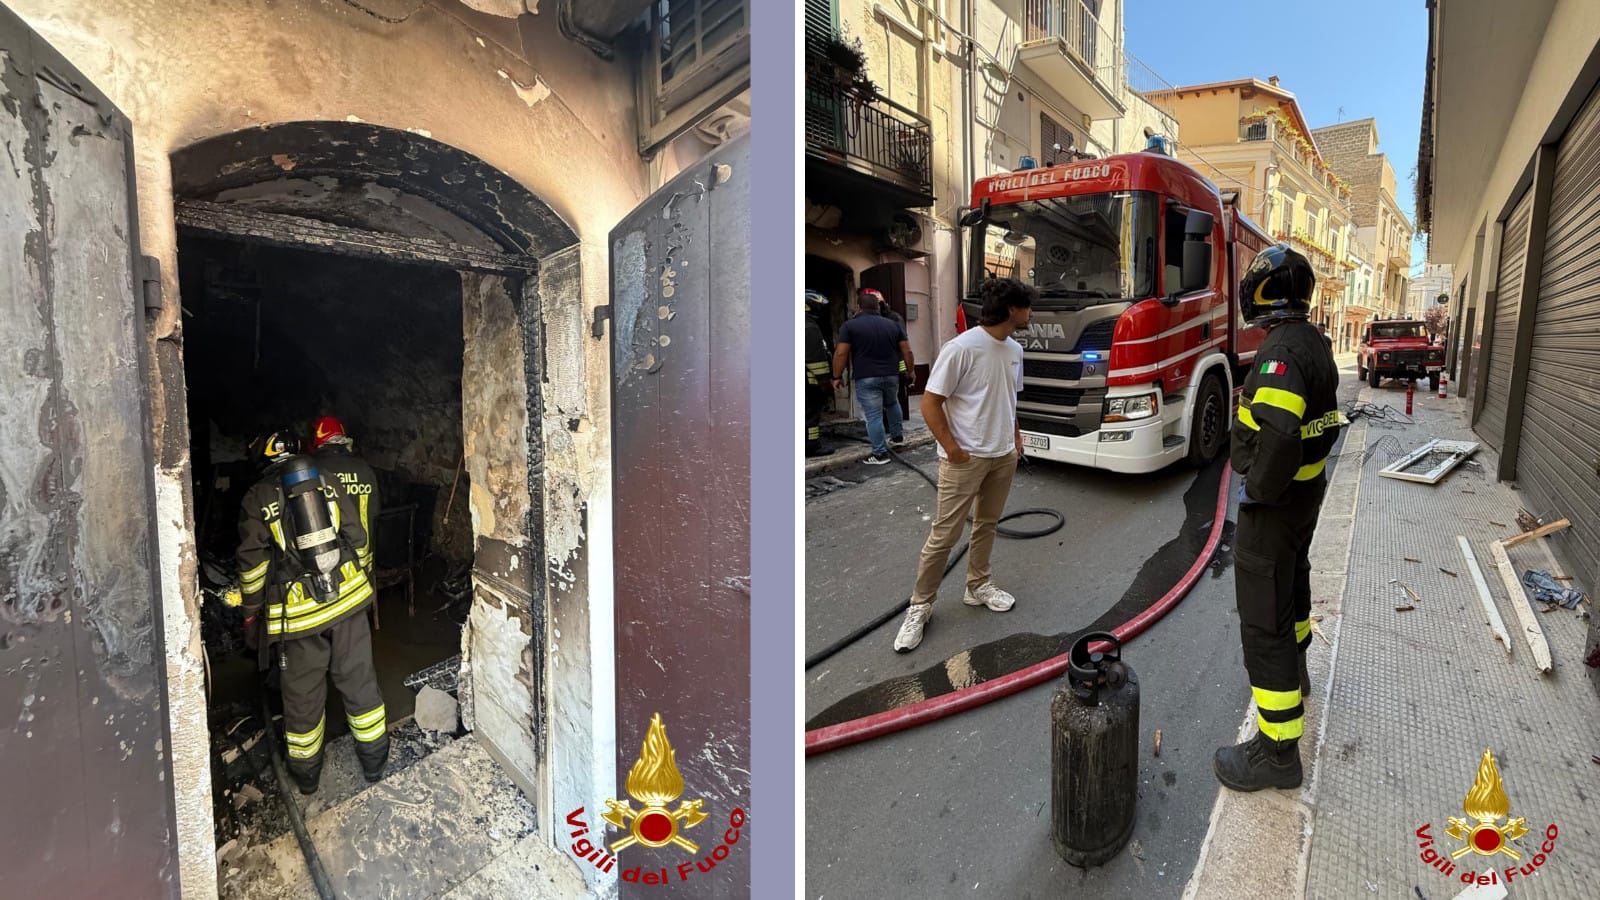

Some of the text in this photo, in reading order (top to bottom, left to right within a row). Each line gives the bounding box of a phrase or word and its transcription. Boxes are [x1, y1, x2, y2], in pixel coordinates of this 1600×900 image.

[989, 164, 1110, 193] VIGILI DEL FUOCO
[1323, 412, 1338, 425] DEL
[335, 472, 358, 483] GILI
